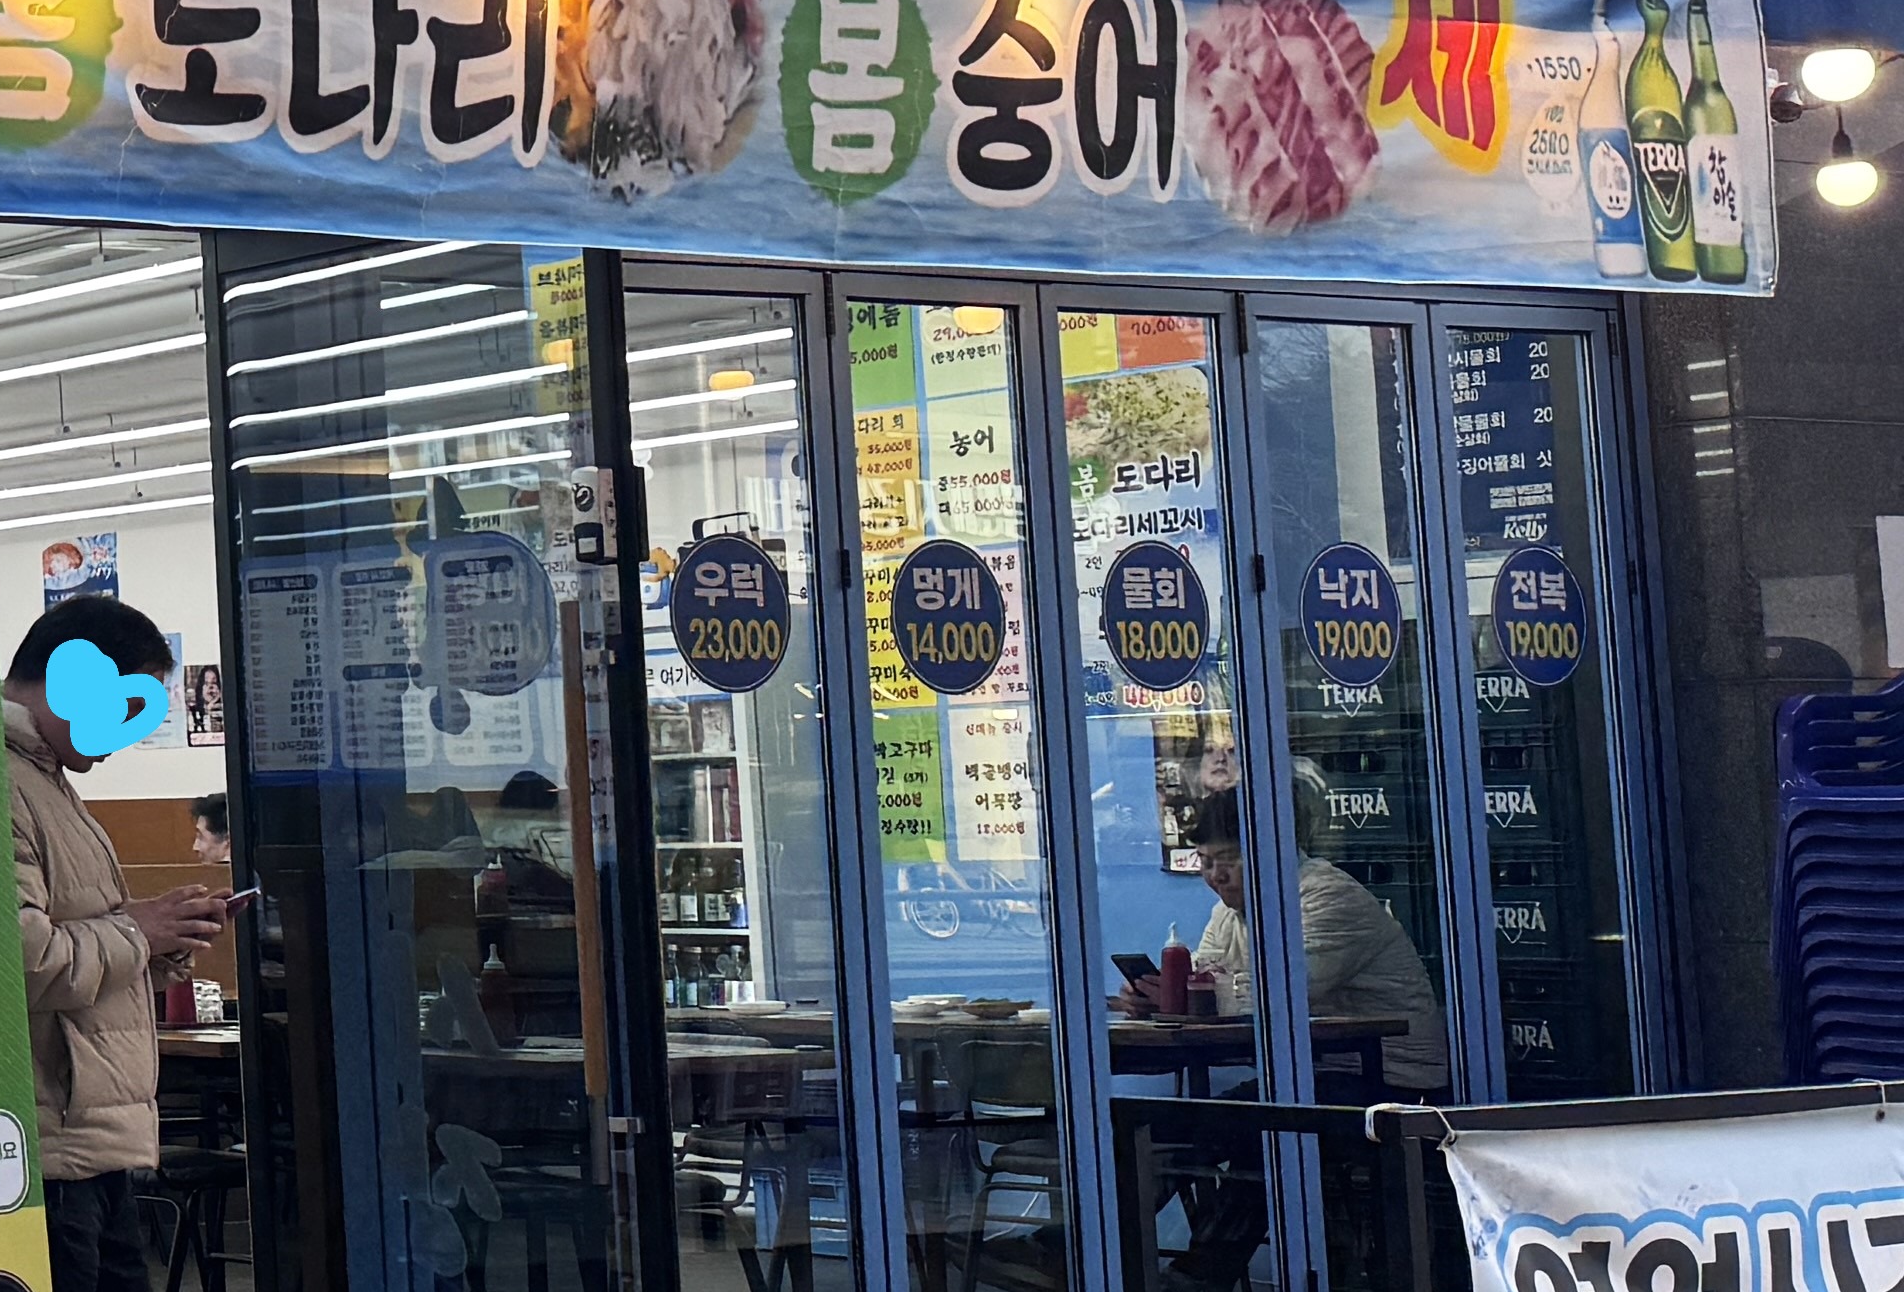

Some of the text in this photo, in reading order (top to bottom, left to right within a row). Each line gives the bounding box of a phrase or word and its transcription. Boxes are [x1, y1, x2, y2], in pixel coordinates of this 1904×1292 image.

[1634, 142, 1686, 172] TERRA
[1529, 341, 1548, 358] 20
[858, 416, 884, 434] 다리
[949, 425, 994, 457] 농어
[1112, 451, 1202, 494] 도다리
[1503, 520, 1548, 541] Kelly
[694, 561, 763, 608] 우럭
[912, 567, 981, 610] 멍게
[1121, 566, 1186, 610] 물회
[1317, 569, 1380, 611] 낙지
[1509, 569, 1569, 613] 전복
[689, 618, 781, 662] 23,000
[906, 621, 996, 665] 14,000
[1116, 620, 1201, 662] 18,000
[1316, 619, 1393, 663] 19,000
[1504, 621, 1579, 666] 19,000
[1318, 678, 1384, 708] TERRA
[1476, 675, 1530, 700] ERRA
[1325, 789, 1390, 818] TERRA
[1485, 790, 1537, 816] ERRA
